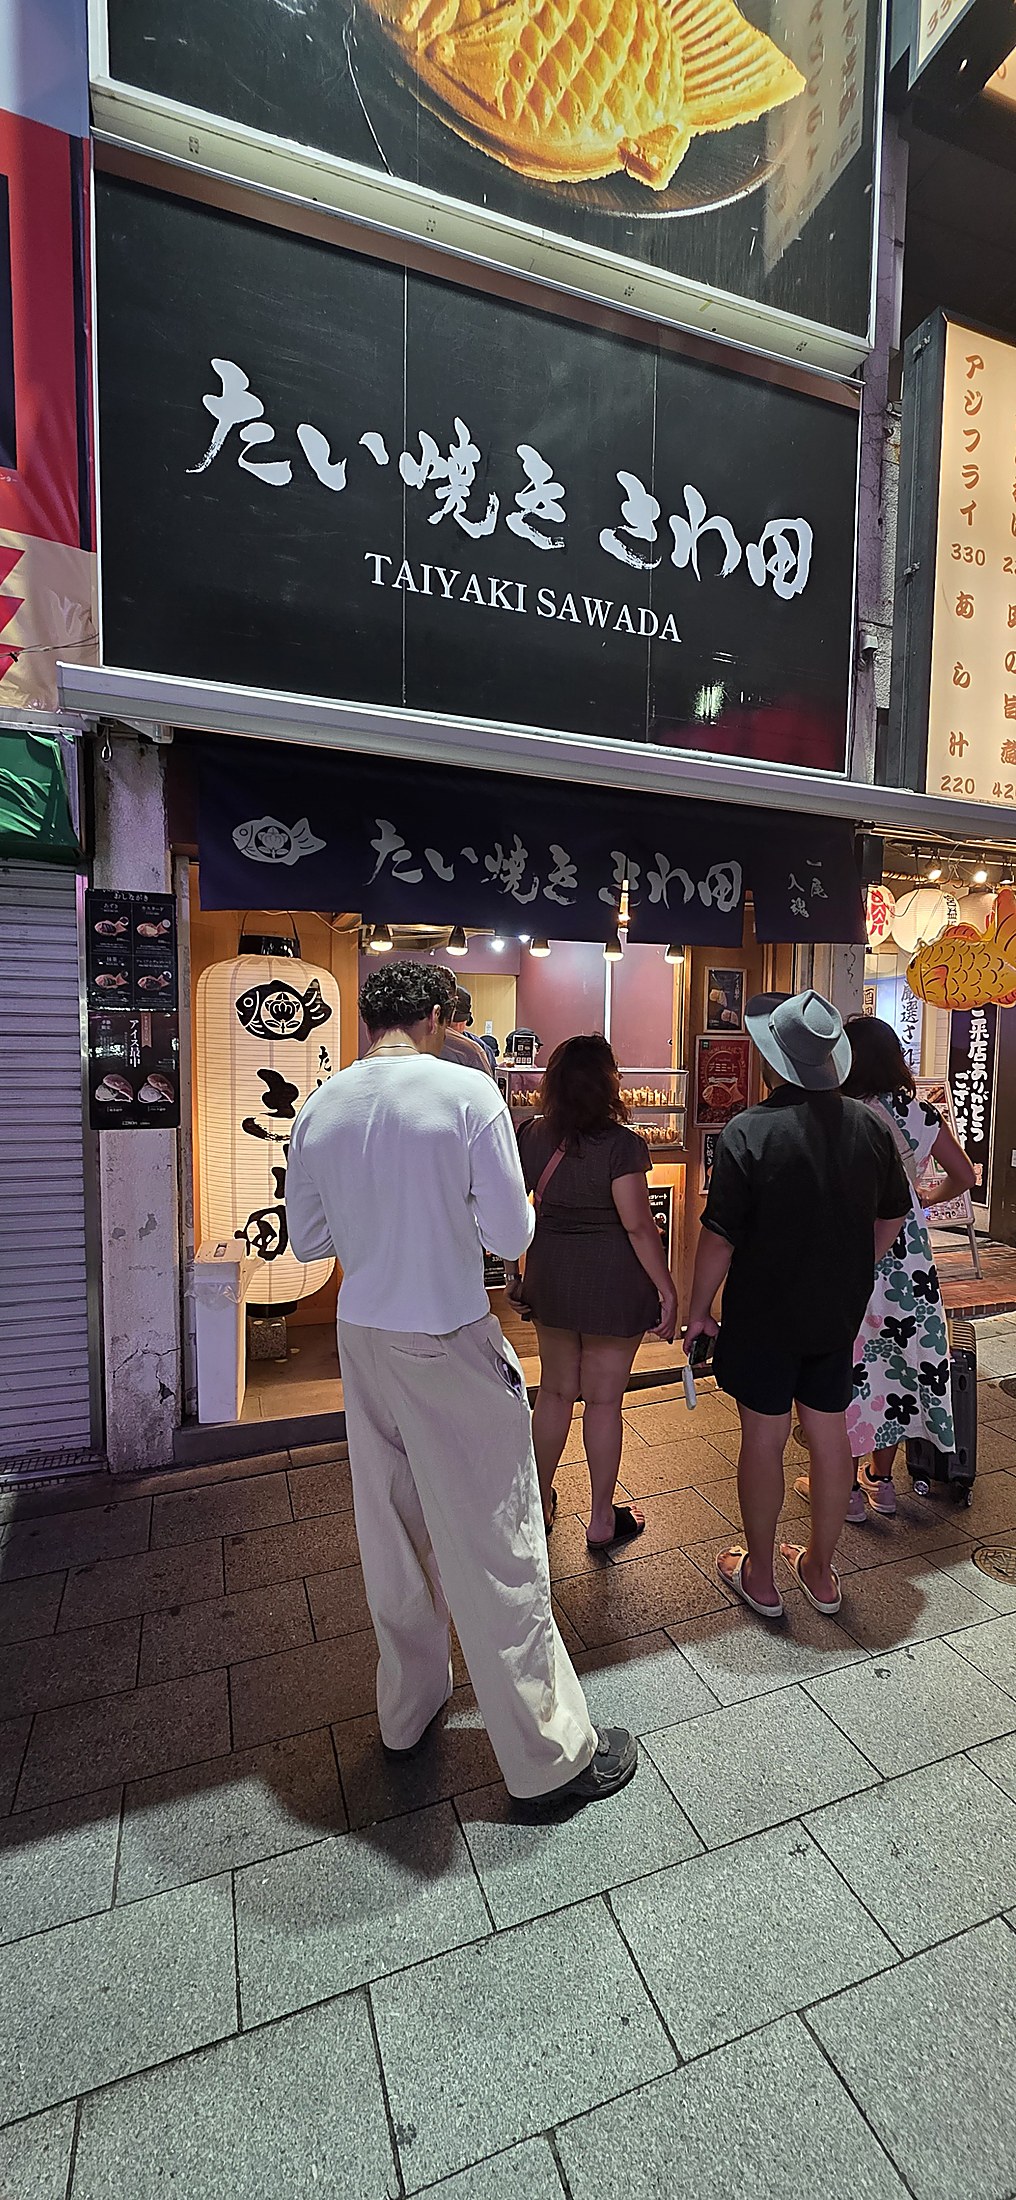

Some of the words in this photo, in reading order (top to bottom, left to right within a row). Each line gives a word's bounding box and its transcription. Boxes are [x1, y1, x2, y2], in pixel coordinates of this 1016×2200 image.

[186, 358, 566, 550] たい焼き
[599, 470, 813, 600] さわ田
[960, 354, 985, 526] アジフライ
[364, 552, 528, 613] TAIYAKI
[536, 588, 683, 643] SAWADA
[950, 543, 986, 567] 330
[949, 590, 975, 758] あら汁
[940, 774, 975, 795] 220
[361, 818, 578, 907] たい焼き
[598, 850, 743, 912] さわ田
